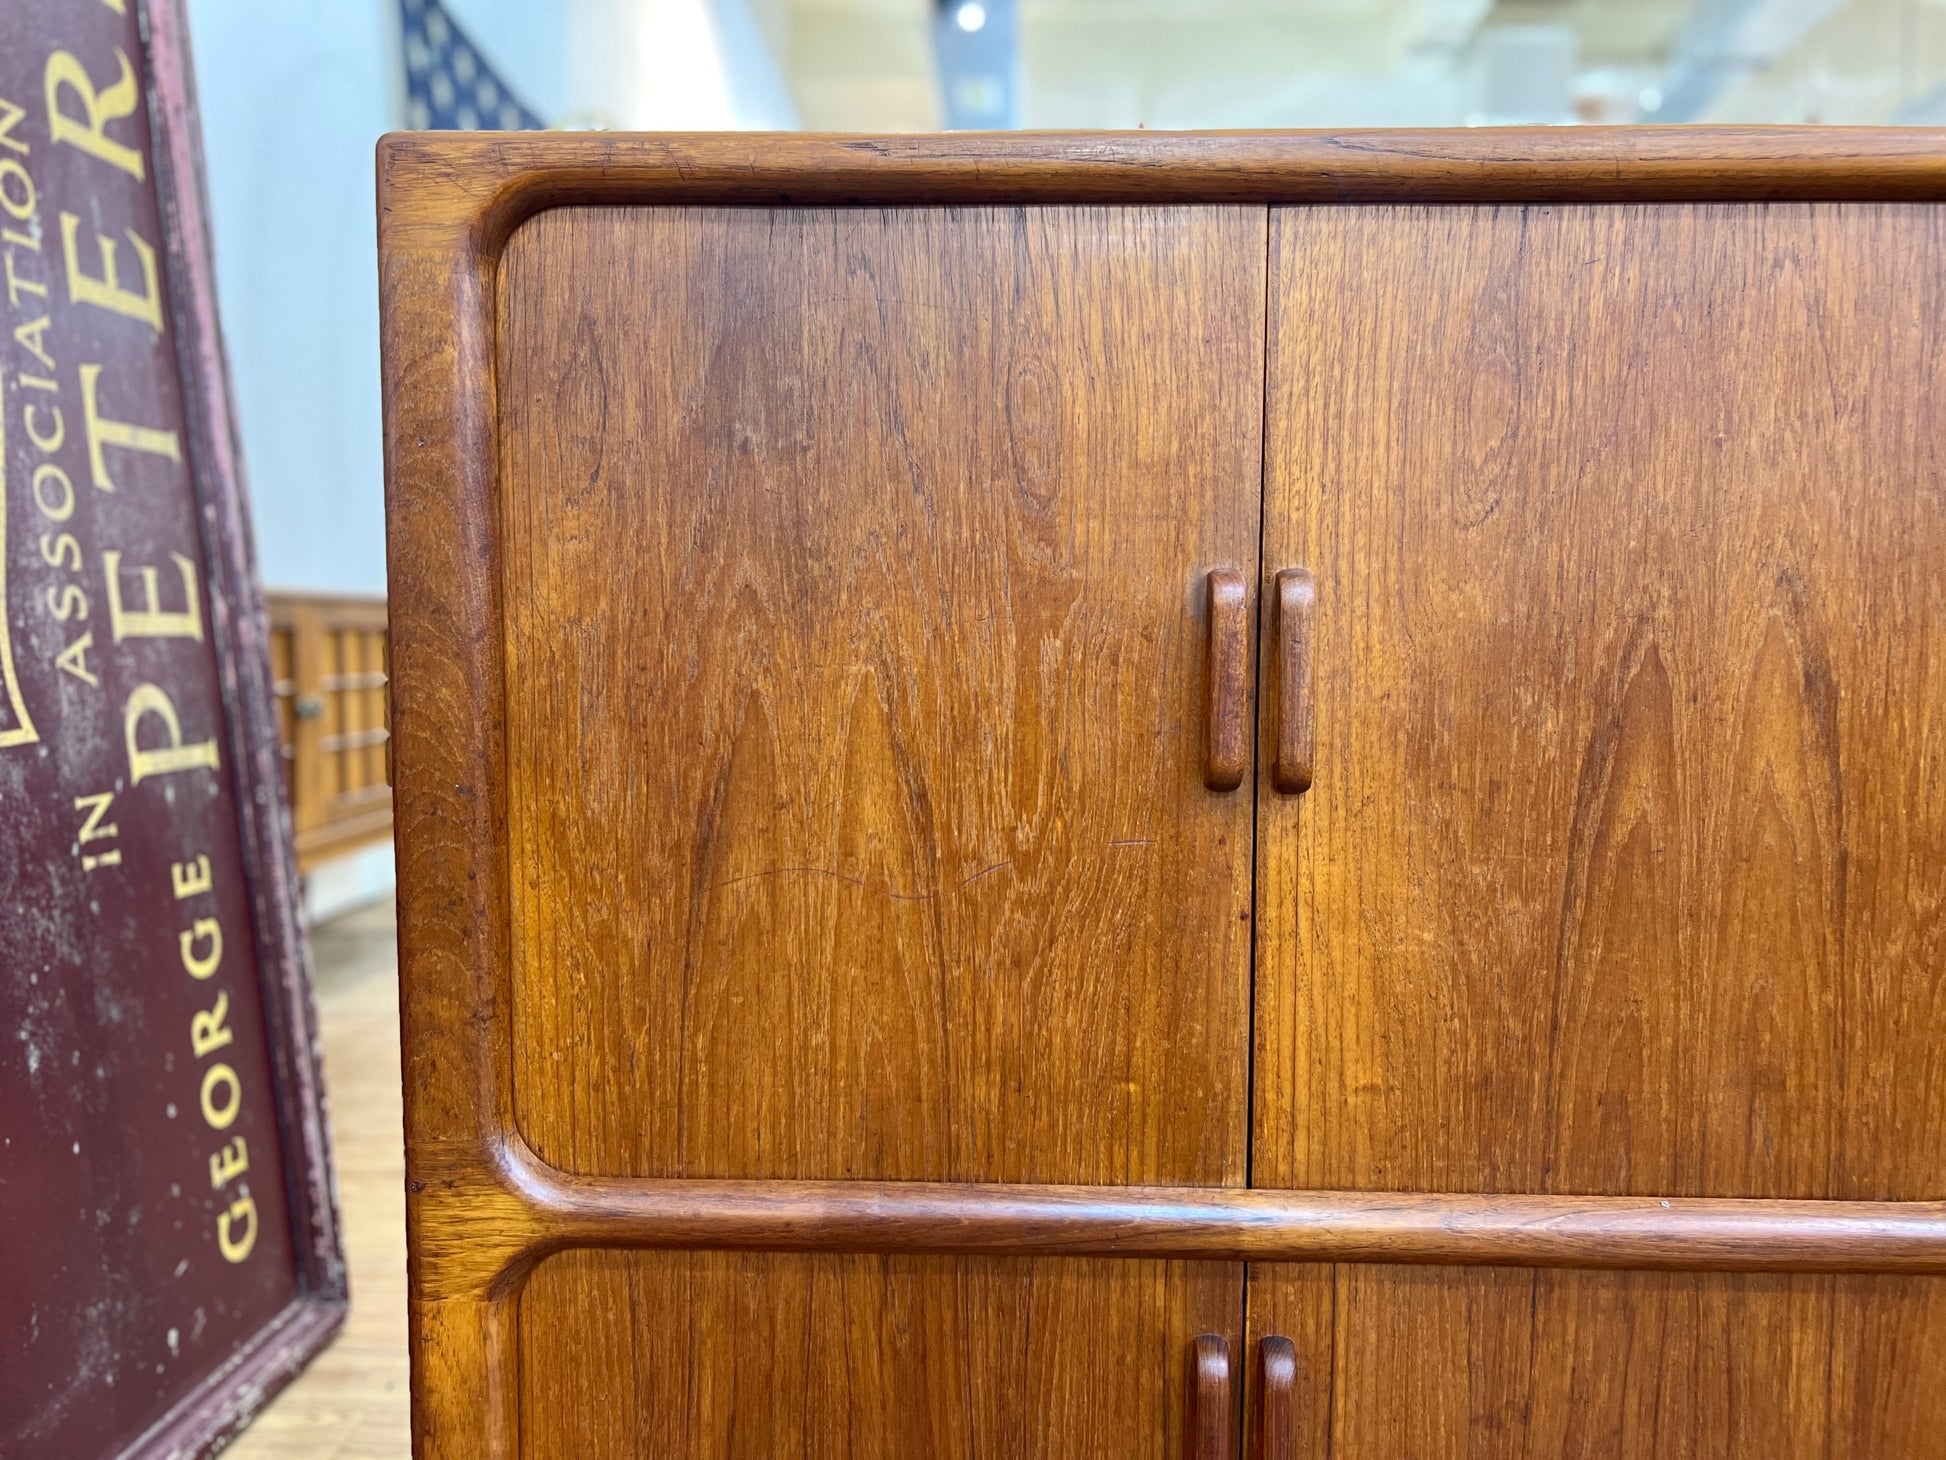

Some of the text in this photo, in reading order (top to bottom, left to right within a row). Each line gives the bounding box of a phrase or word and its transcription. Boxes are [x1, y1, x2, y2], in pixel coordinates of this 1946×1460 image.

[0, 97, 122, 872] IN ASSOCIATION
[43, 0, 258, 1263] GEORGE PETER
